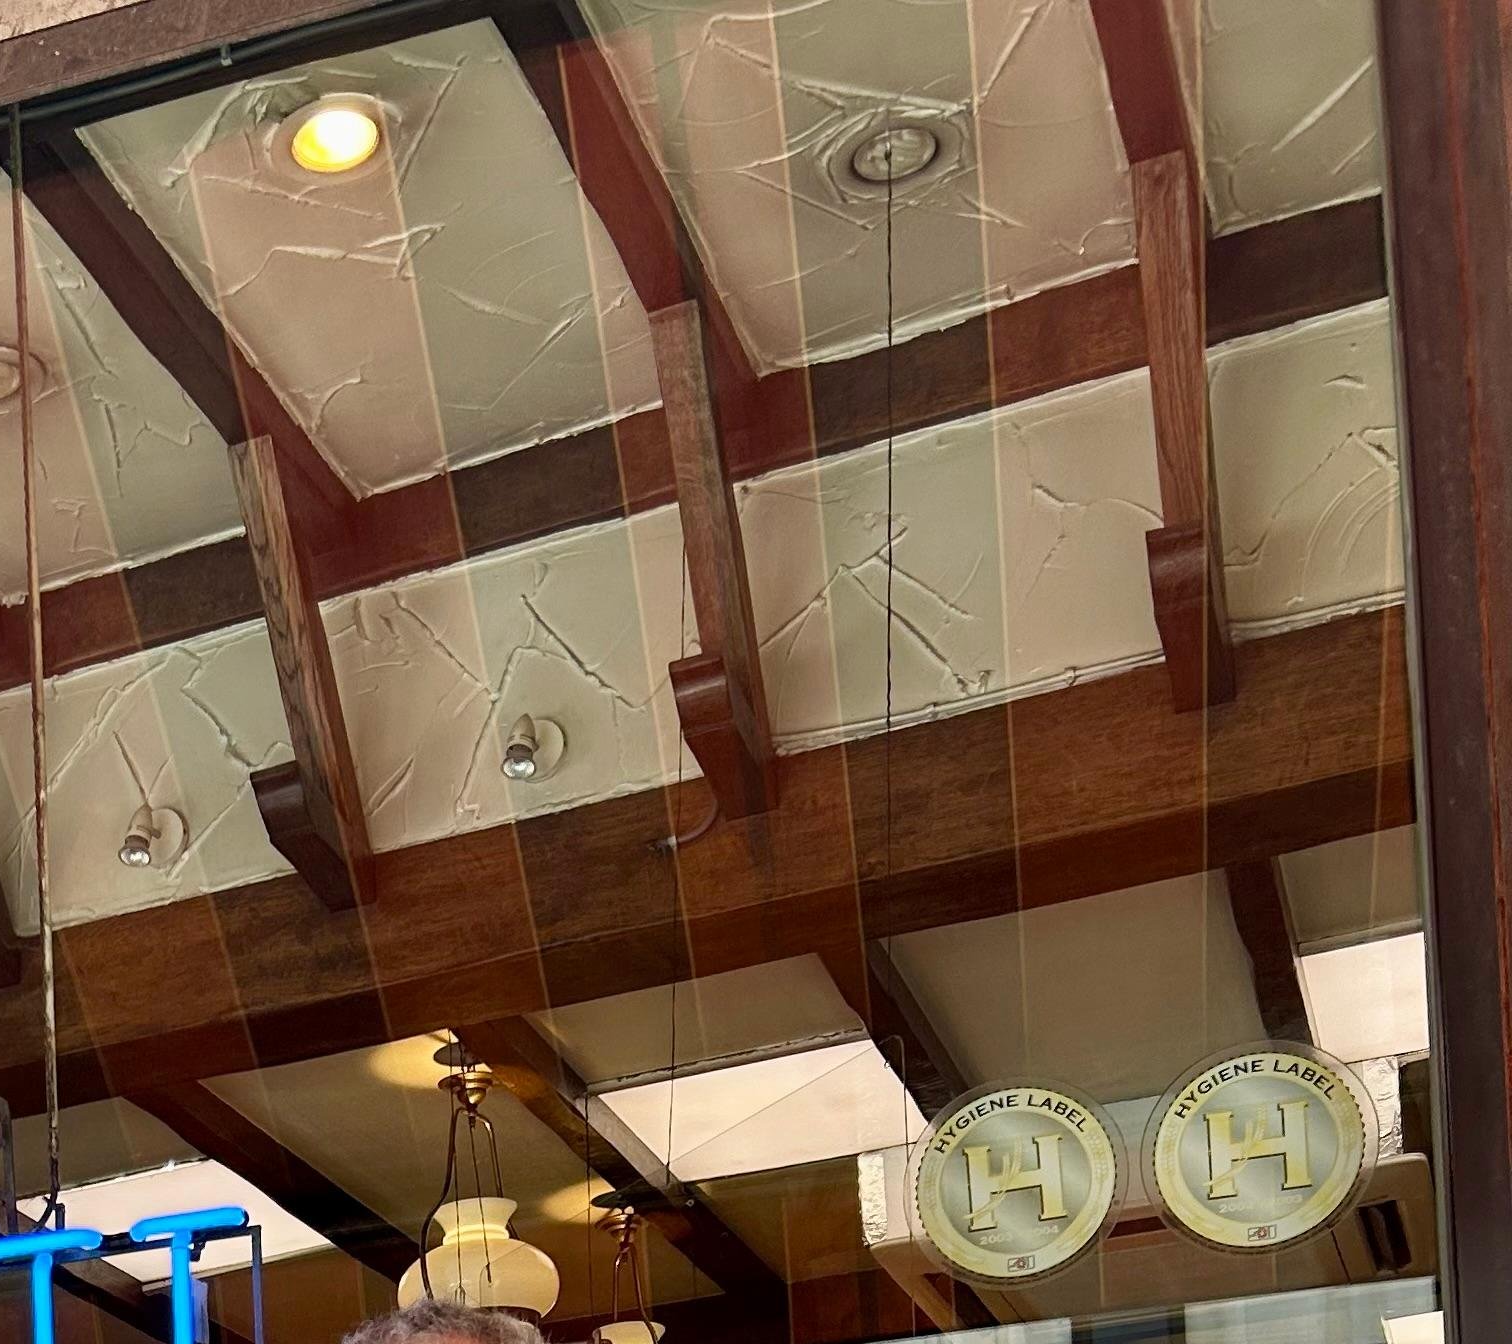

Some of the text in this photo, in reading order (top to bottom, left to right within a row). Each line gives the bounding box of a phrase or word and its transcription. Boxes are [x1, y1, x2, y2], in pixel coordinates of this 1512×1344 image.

[1174, 1059, 1336, 1119] HYGIENE LABEL
[934, 1093, 1089, 1154] HYGIENE LABEL
